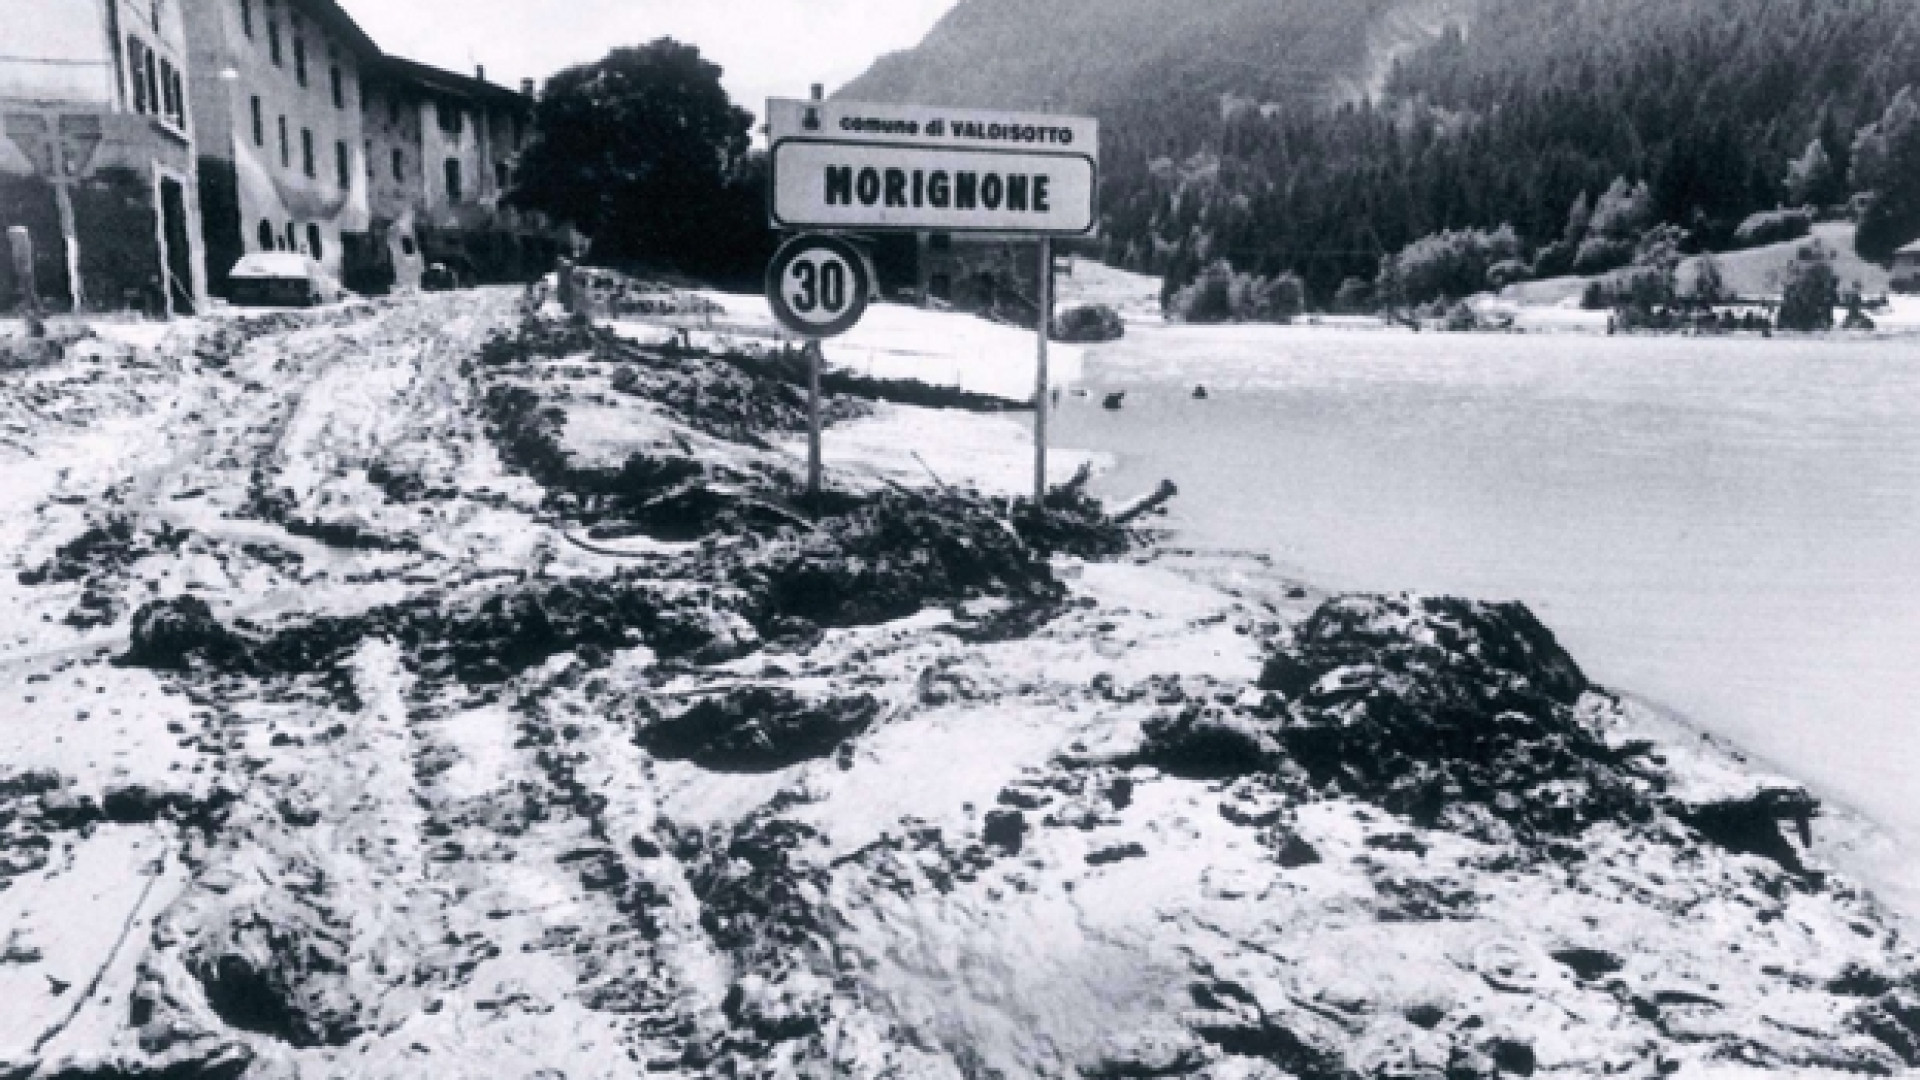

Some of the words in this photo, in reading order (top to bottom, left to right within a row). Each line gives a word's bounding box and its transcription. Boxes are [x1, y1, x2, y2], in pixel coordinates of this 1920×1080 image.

[925, 117, 945, 137] di
[950, 120, 1074, 144] VALDISOTTO
[824, 164, 1051, 212] MORIGNONE
[792, 259, 847, 313] 30
